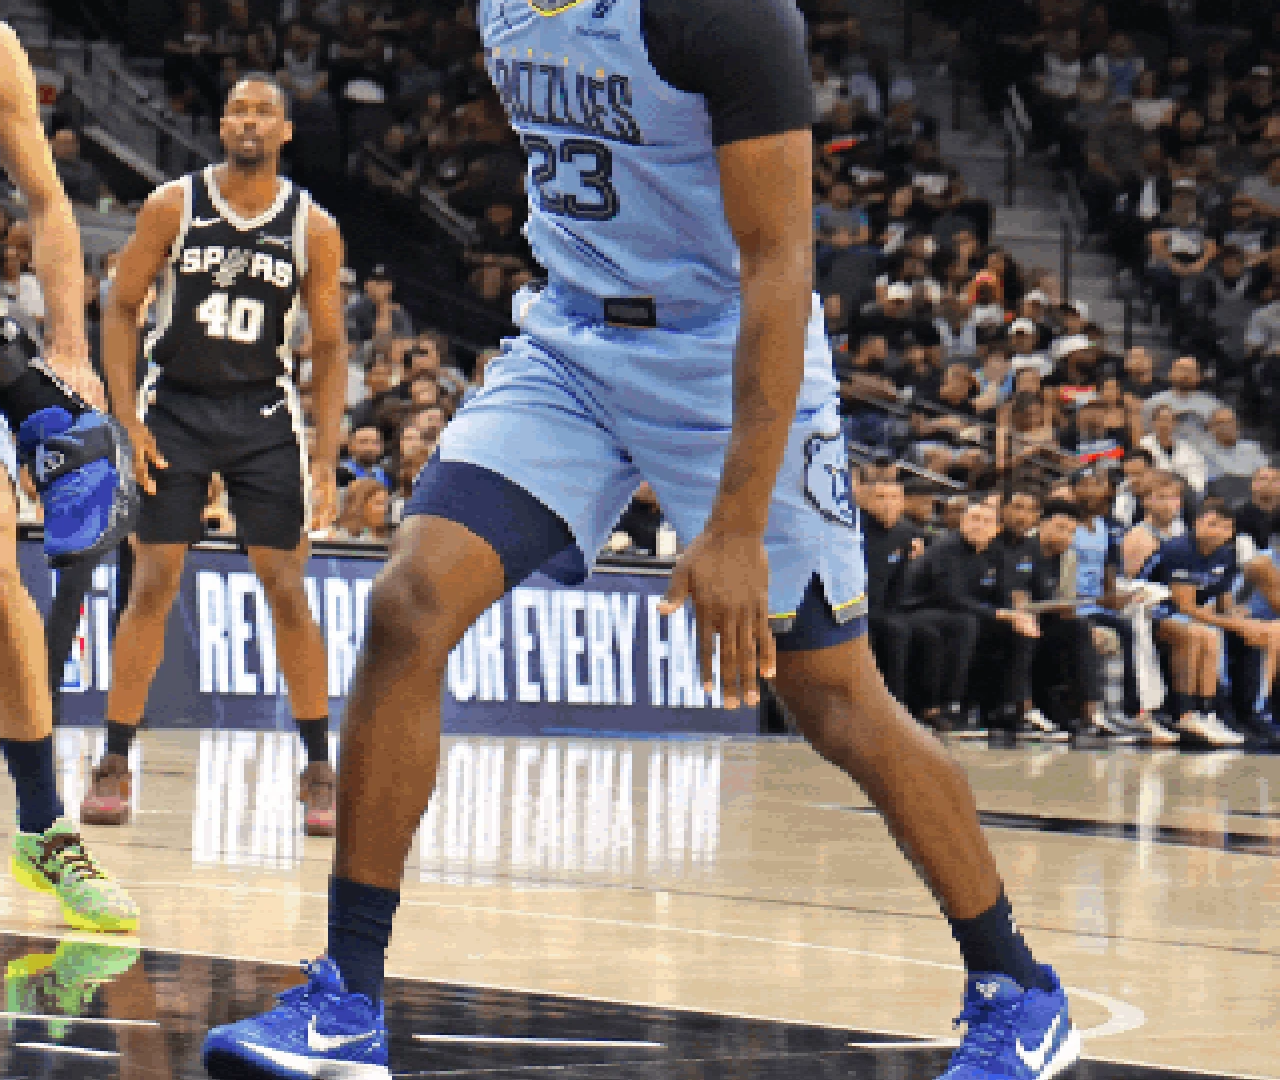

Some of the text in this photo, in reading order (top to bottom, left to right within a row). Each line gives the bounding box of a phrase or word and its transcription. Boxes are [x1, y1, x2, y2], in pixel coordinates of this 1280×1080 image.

[520, 134, 621, 222] 23
[195, 292, 264, 342] 40
[512, 586, 639, 706] EVERY
